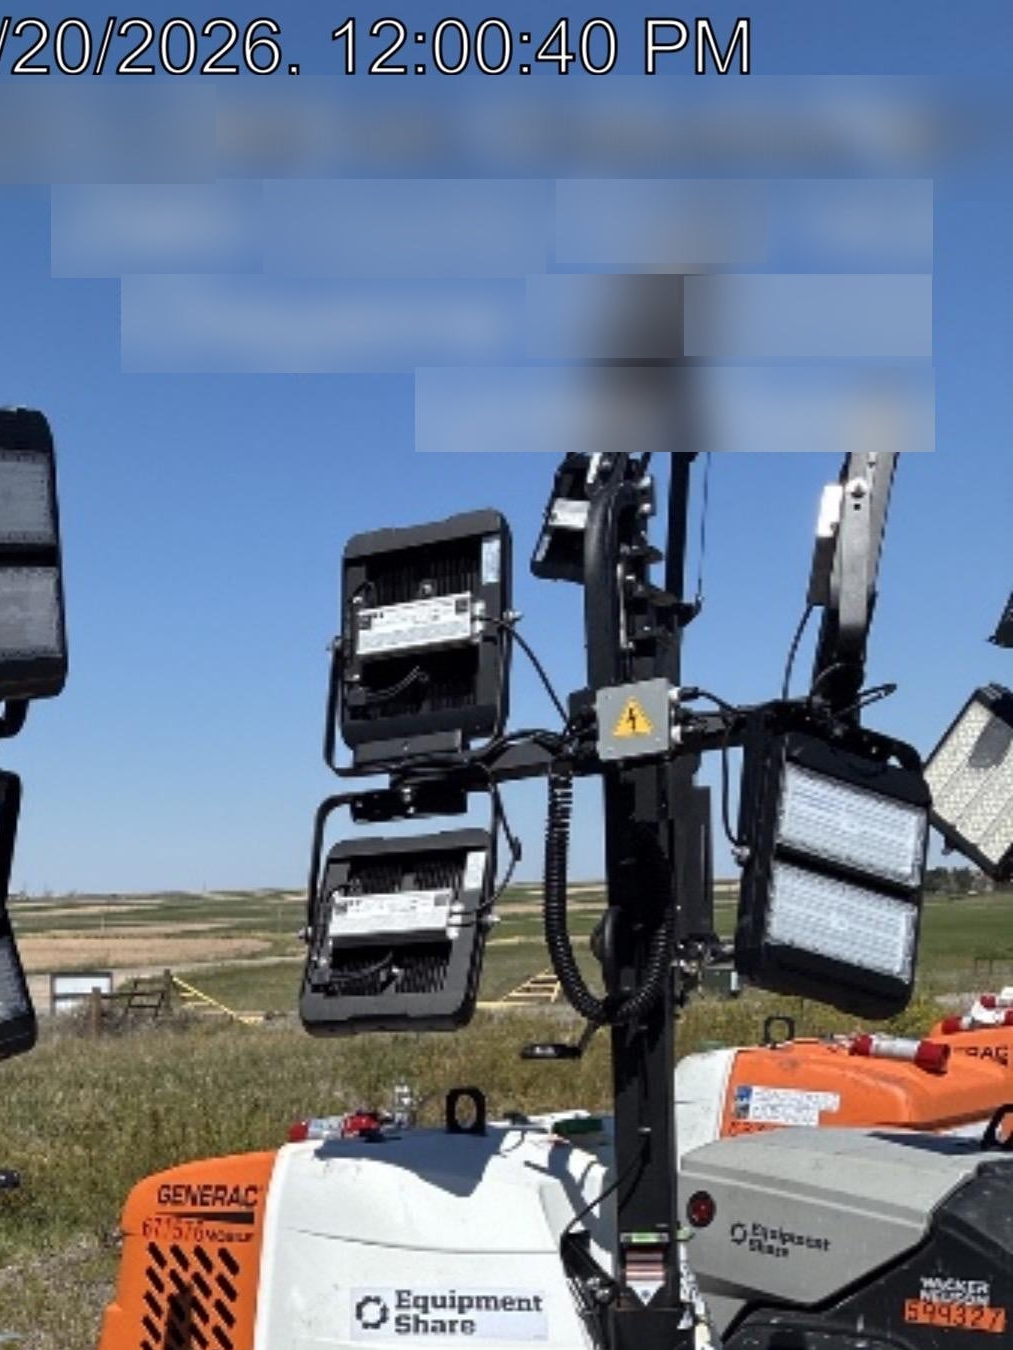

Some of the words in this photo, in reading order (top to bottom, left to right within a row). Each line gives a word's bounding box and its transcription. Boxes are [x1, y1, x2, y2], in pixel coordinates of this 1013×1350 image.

[157, 1184, 258, 1206] GENERAC
[920, 1277, 990, 1294] WACKER
[395, 1289, 543, 1314] Equipment
[395, 1313, 477, 1335] Share
